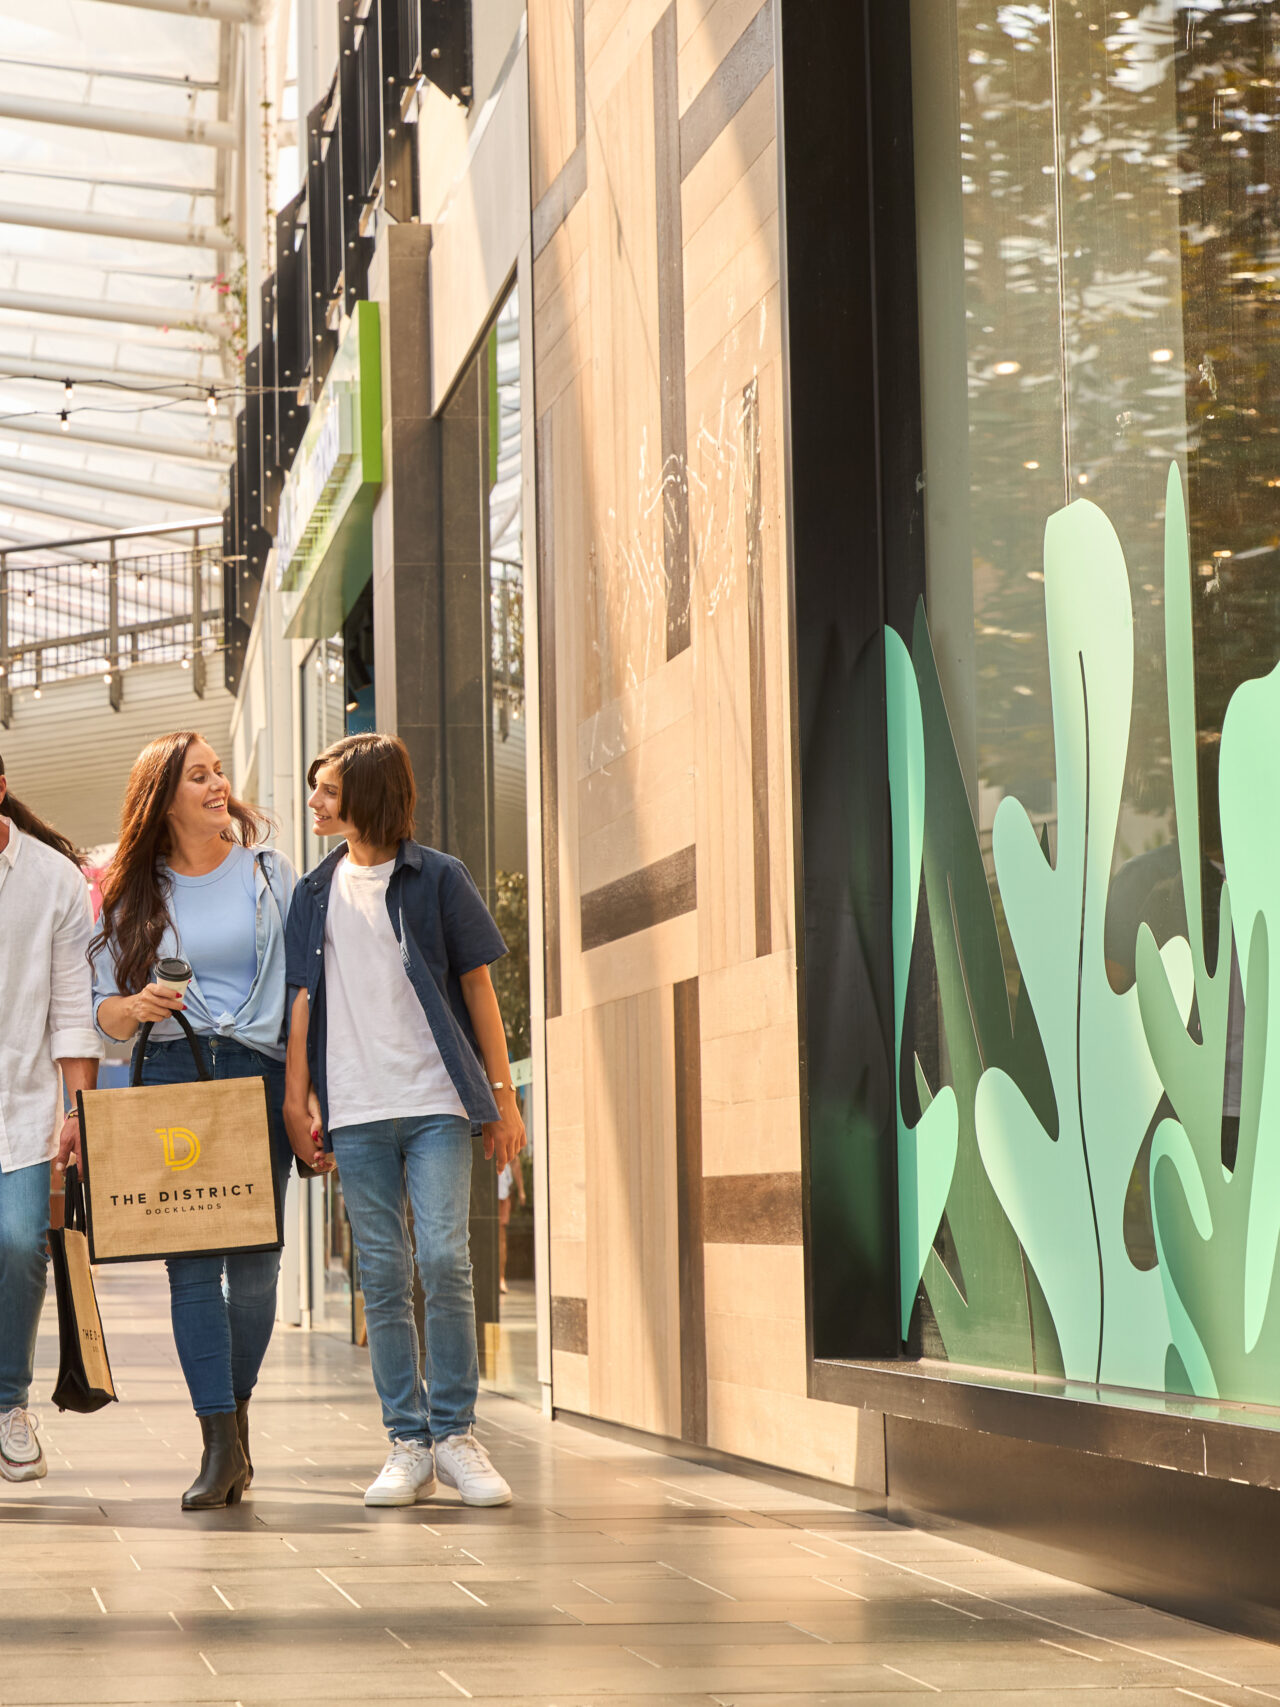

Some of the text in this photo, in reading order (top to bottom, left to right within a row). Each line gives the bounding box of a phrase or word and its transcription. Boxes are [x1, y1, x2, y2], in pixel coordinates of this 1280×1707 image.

[110, 1183, 254, 1206] THE DISTRICT
[145, 1202, 222, 1215] DOCKLANDS
